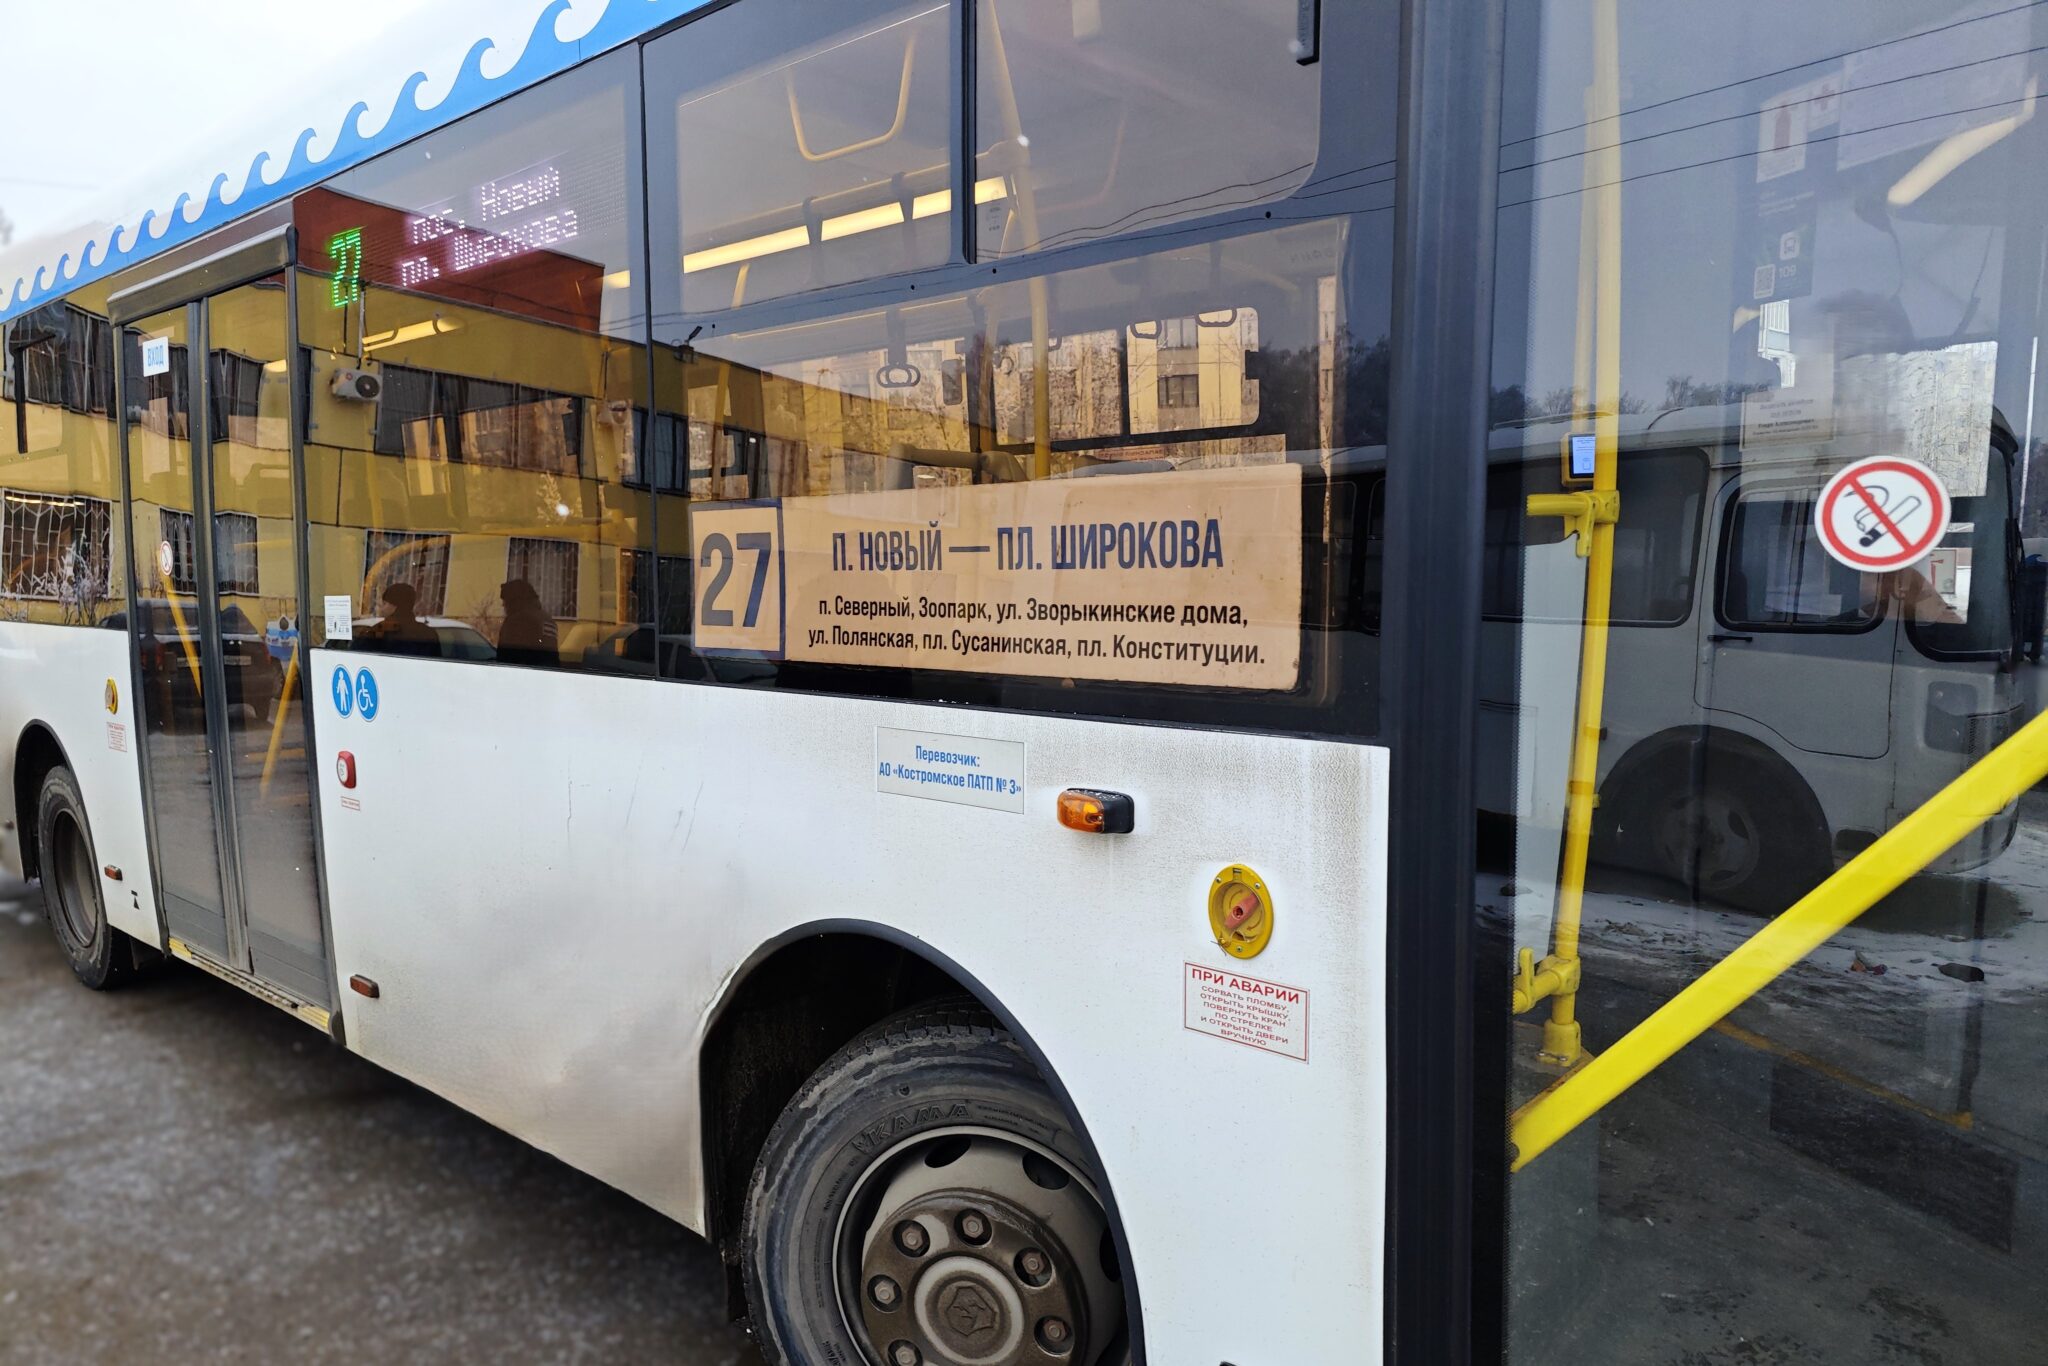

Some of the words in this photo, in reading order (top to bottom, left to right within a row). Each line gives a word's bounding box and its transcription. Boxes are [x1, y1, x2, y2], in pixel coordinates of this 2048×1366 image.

[481, 167, 559, 221] Новый
[454, 210, 578, 271] Широкова
[331, 232, 361, 306] 27
[147, 345, 164, 367] ВХОД
[832, 533, 853, 571] П.
[859, 520, 942, 571] НОВЫЙ
[997, 526, 1042, 570] ПЛ.
[1051, 519, 1224, 569] ШИРОКОВА
[700, 532, 772, 627] 27
[819, 600, 831, 615] п.
[835, 595, 915, 619] Северный,
[919, 597, 991, 622] Зоопарк,
[996, 602, 1022, 624] ул.
[1027, 597, 1175, 625] Зворыкинские
[1181, 604, 1248, 628] дома,
[808, 629, 829, 648] ул.
[832, 625, 918, 651] Полянская,
[923, 634, 947, 650] пл.
[952, 630, 1071, 658] Сусанинская,
[1077, 640, 1107, 657] пл.
[1113, 634, 1265, 666] Конституции.
[915, 745, 981, 767] Перевозчик:
[879, 762, 891, 777] АО
[893, 764, 965, 787] «Костромское
[967, 773, 993, 791] ПАТП
[996, 777, 1007, 793] №
[1009, 779, 1022, 795] 3»
[1192, 968, 1224, 986] ПРИ
[1229, 978, 1299, 1004] АВАРИИ
[1200, 993, 1244, 1009] ОТКРЫТЬ
[1201, 985, 1244, 1001] СОРВАТЬ
[1203, 1001, 1258, 1021] ПОВЕРНУТЬ
[1261, 1016, 1286, 1028] КРАН
[1209, 1018, 1253, 1034] ОТКРЫТЬ
[1255, 1031, 1289, 1044] ДВЕРИ
[1215, 1012, 1228, 1020] ПО
[1230, 1016, 1273, 1032] СТРЕЛКЕ
[1220, 1029, 1267, 1046] ВРУЧНУЮ
